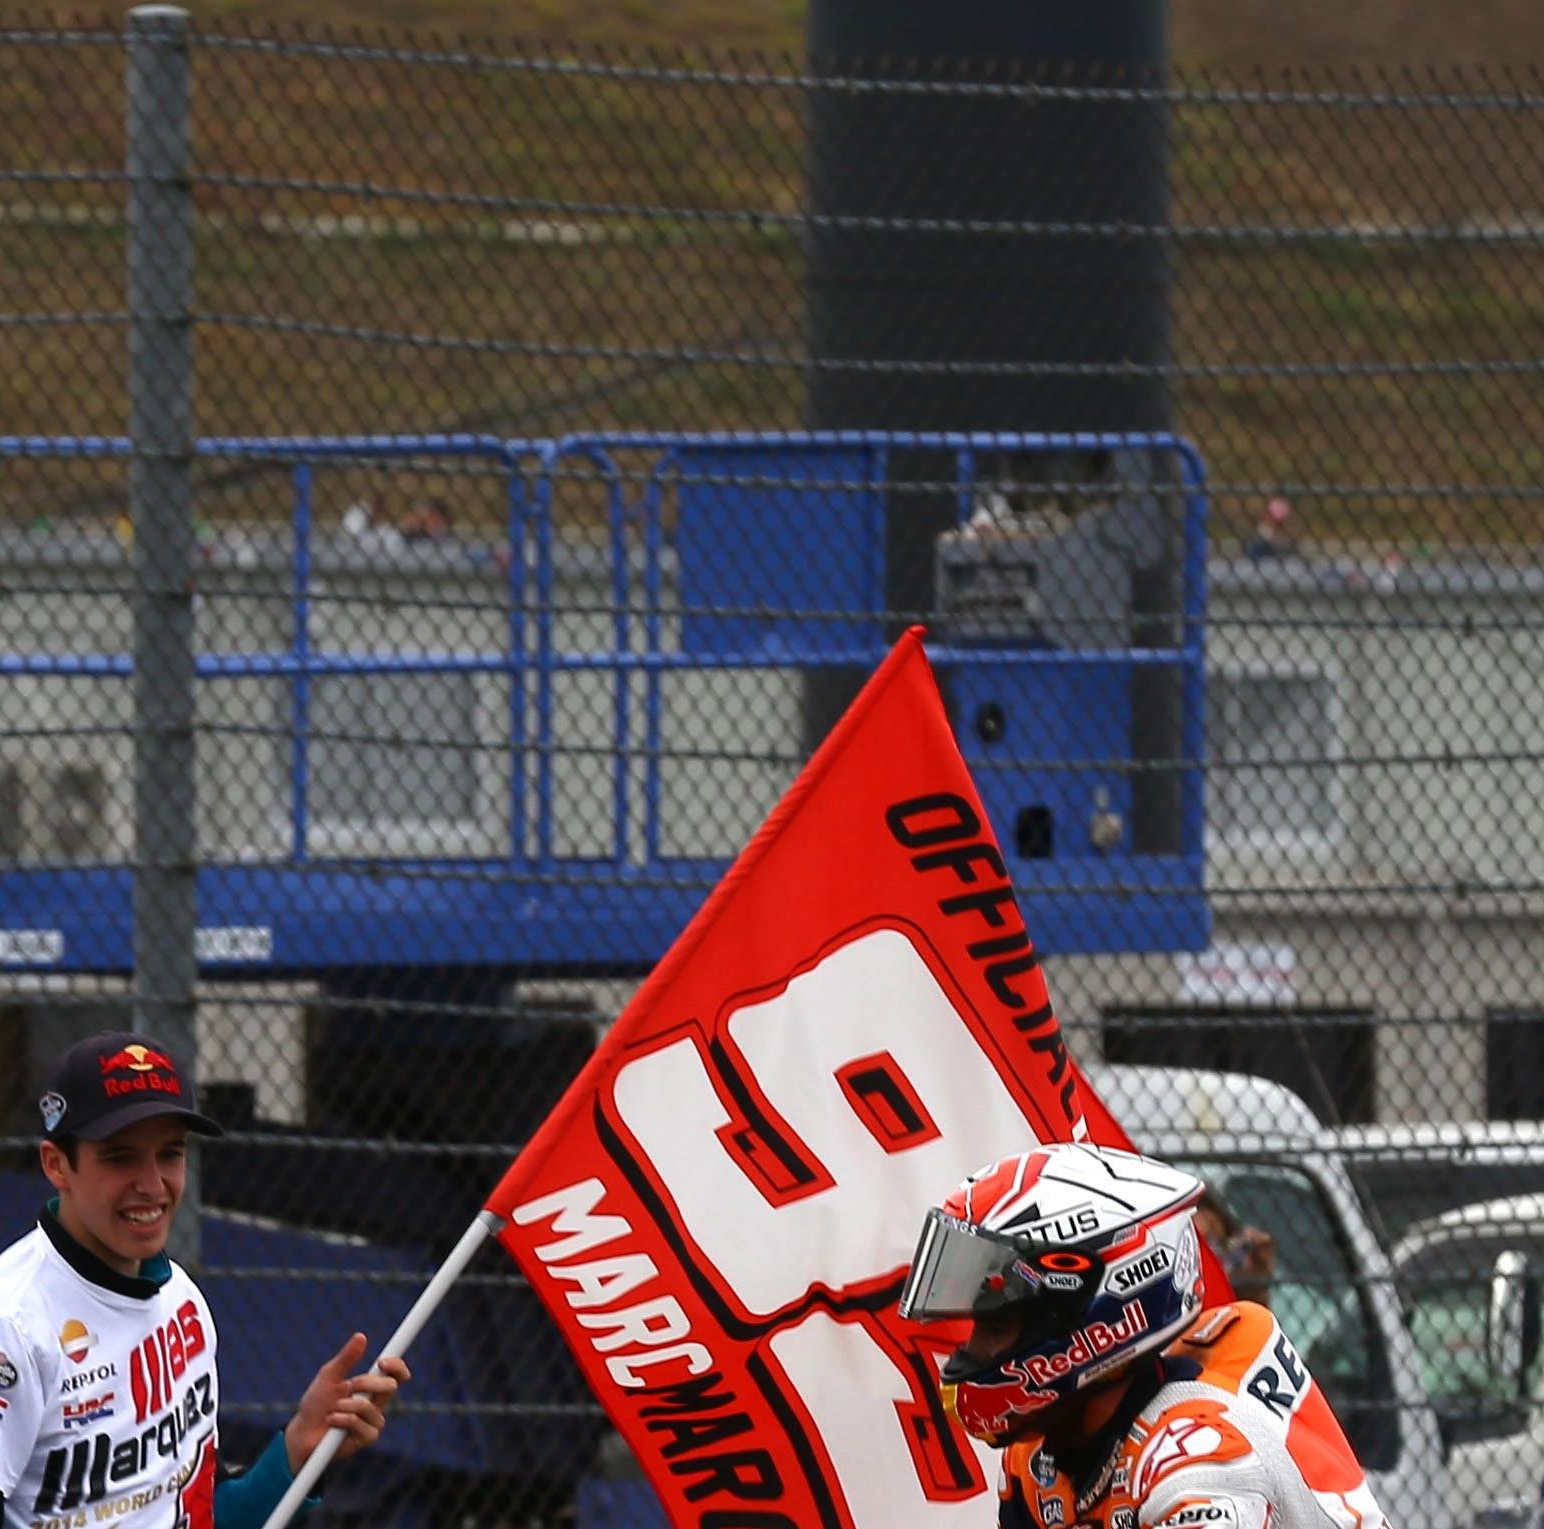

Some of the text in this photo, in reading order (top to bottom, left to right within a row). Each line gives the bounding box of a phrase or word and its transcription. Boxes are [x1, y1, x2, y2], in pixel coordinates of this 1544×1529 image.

[105, 1071, 182, 1098] Red Bull
[512, 1177, 713, 1388] MARC
[1049, 1275, 1079, 1289] SHOEI
[1114, 1249, 1170, 1292] SHOEI
[1023, 1329, 1093, 1388] Red
[1085, 1299, 1149, 1357] Bull
[60, 1362, 118, 1393] REPSOL
[62, 1392, 115, 1429] HRC
[93, 1484, 163, 1524] WORLD
[1043, 1501, 1065, 1527] GAS
